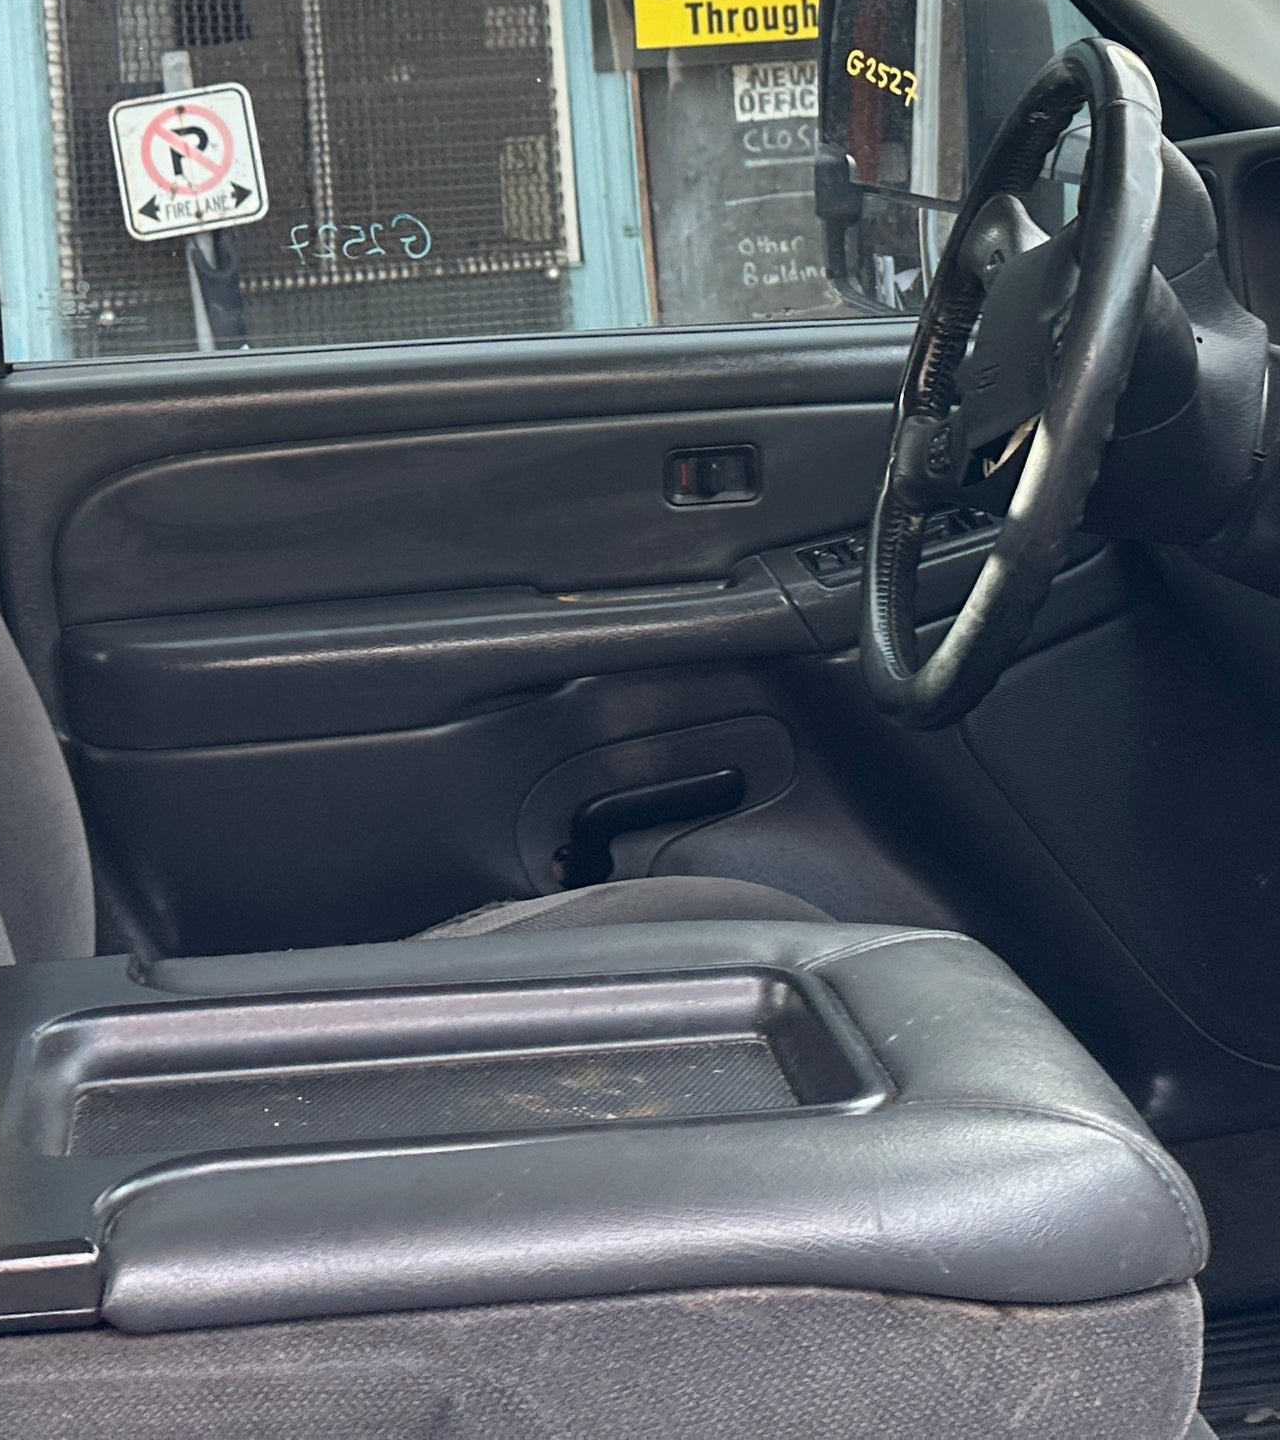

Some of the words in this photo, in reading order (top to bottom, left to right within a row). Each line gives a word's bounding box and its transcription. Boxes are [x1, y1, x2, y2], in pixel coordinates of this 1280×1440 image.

[750, 64, 816, 89] NEW
[847, 49, 918, 107] G2527
[739, 88, 815, 114] OFFIC
[165, 200, 193, 221] FIRE
